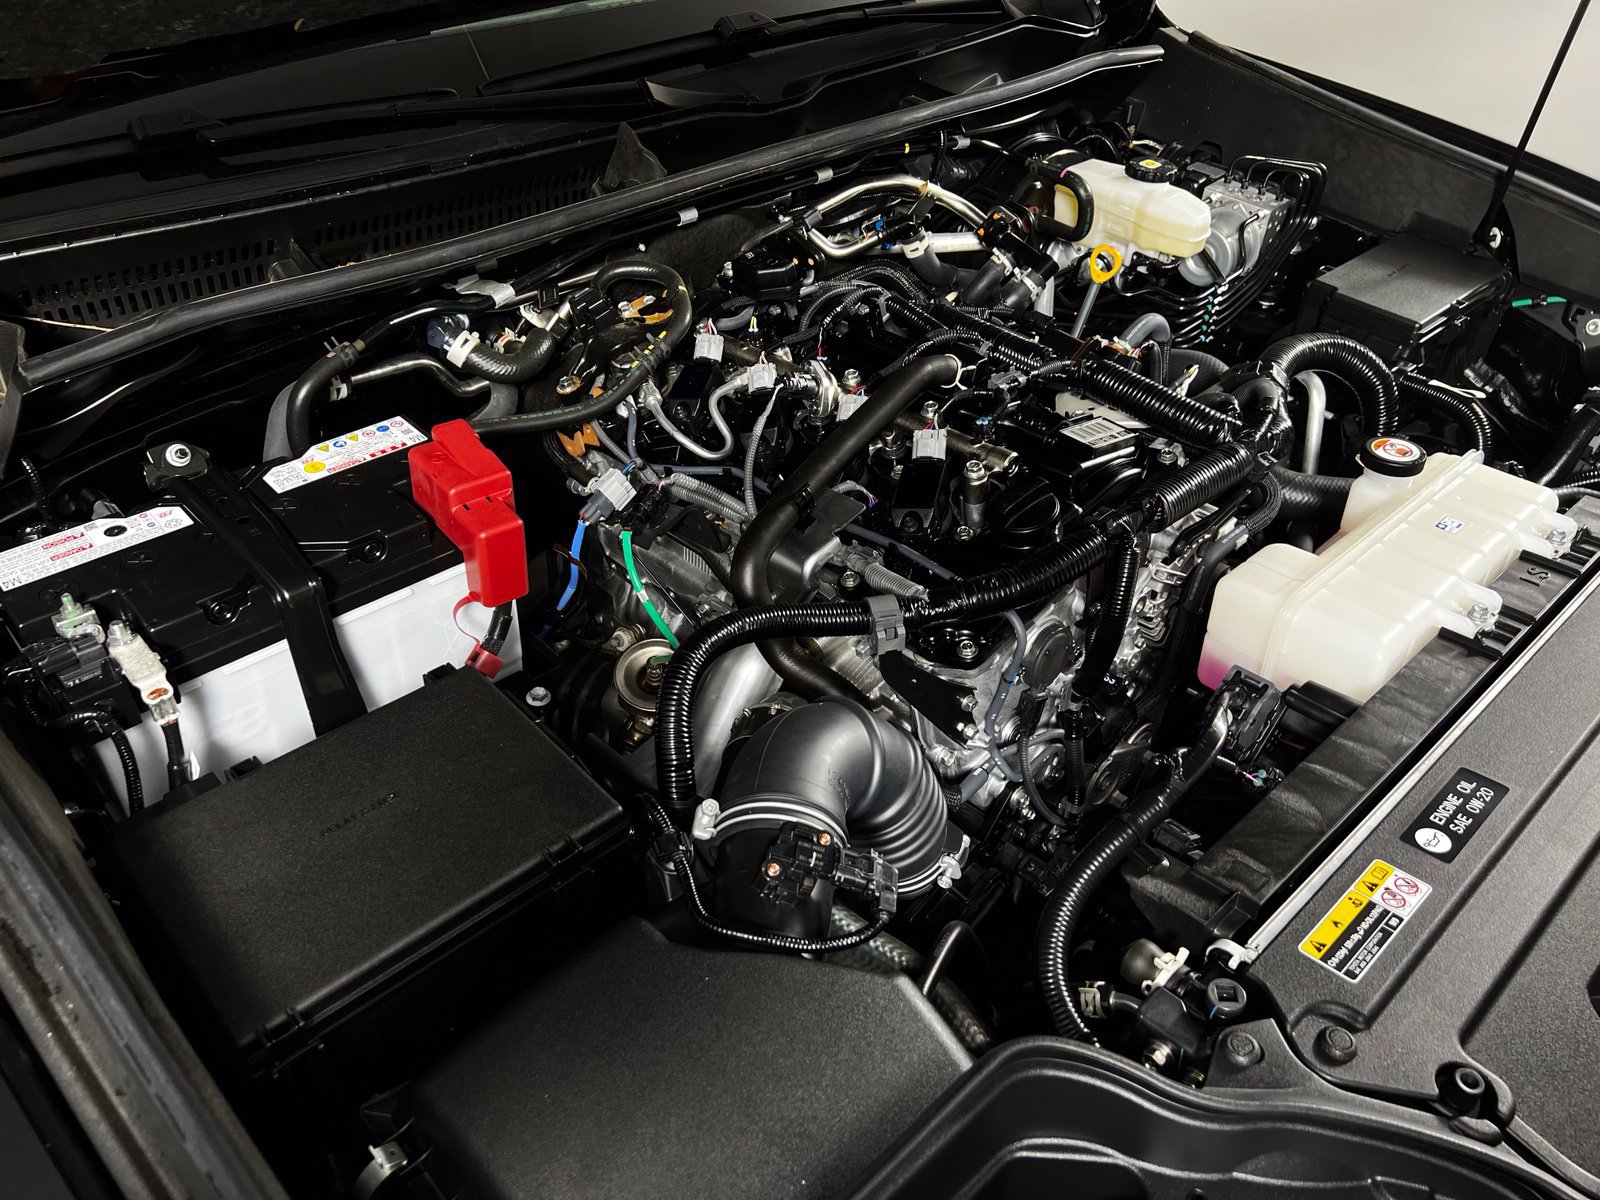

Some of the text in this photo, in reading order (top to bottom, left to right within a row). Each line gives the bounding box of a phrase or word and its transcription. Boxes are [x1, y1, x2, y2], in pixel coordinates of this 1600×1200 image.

[42, 535, 74, 549] POISON
[50, 546, 82, 561] DANGER
[1, 575, 22, 589] M4
[1429, 780, 1477, 825] ENGINE OIL
[1449, 787, 1495, 835] SAE 0W-20
